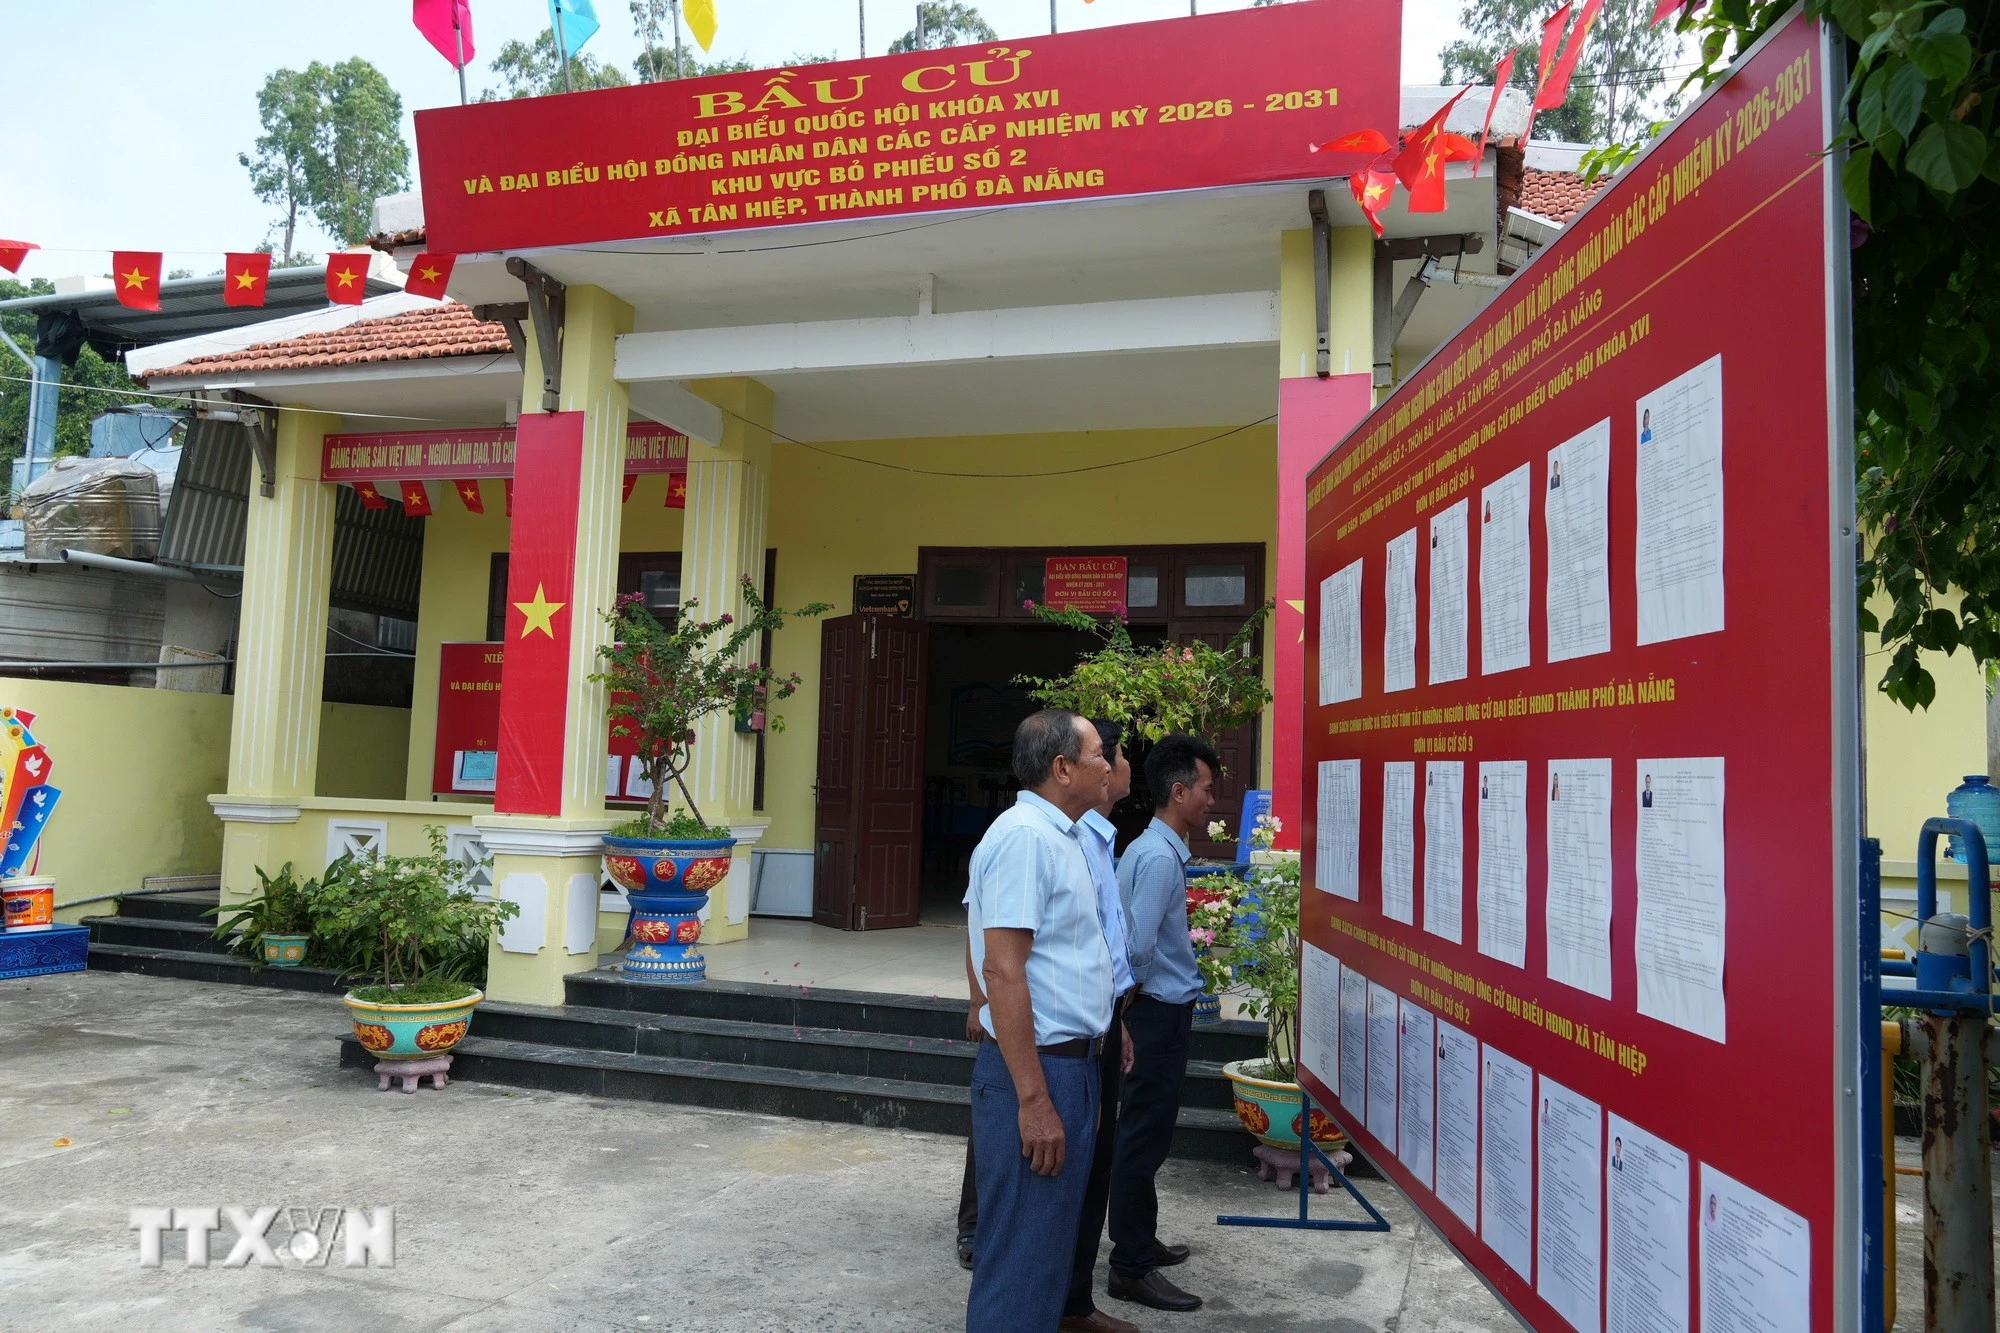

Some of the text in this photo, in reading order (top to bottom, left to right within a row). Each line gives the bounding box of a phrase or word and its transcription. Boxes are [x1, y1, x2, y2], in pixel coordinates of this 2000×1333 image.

[692, 48, 1032, 119] BẦU CỬ
[464, 175, 493, 194] VÀ
[500, 173, 538, 192] ĐẠI
[546, 162, 599, 186] BIỂU
[607, 160, 647, 181] HỘI
[655, 151, 723, 175] ĐỒNG
[732, 143, 804, 167] NHÂN
[813, 137, 867, 158] DÂN
[877, 130, 930, 151] CÁC
[941, 119, 996, 144] CẤP
[1006, 113, 1100, 138] NHIỆM
[1112, 105, 1148, 128] KỲ
[1159, 99, 1232, 123] 2026
[1266, 88, 1337, 111] 2031
[677, 89, 1059, 148] ĐẠI BIỂU QUỐC HỘI KHÓA XVI
[712, 145, 1026, 195] KHU VỰC BỎ PHIẾU SỐ 2
[649, 167, 1104, 227] XÃ TÂN HIỆP, THÀNH PHỐ ĐÀ NẴNG
[1467, 331, 1482, 378] QUỐC
[1484, 323, 1494, 366] HỘI
[1495, 308, 1512, 352] KHÓA
[1514, 300, 1524, 337] XVI
[1526, 284, 1536, 325] VÀ
[1538, 273, 1550, 320] HỘI
[1552, 254, 1574, 305] ĐỒNG
[1577, 232, 1601, 285] NHÂN
[1604, 213, 1623, 263] DÂN
[1626, 192, 1645, 244] CÁC
[1649, 163, 1670, 225] CẤP
[1673, 135, 1712, 205] NHIỆM
[1716, 110, 1732, 170] KỲ
[1736, 48, 1811, 153] 2026-2031
[1393, 441, 1400, 464] SỐ
[1401, 444, 1406, 459] 2
[1408, 429, 1423, 453] THÔN
[1424, 419, 1433, 441] BÃI
[1437, 406, 1455, 432] LÀNG,
[1457, 392, 1466, 417] XÃ
[1468, 383, 1481, 407] TÂN
[1483, 368, 1500, 396] HIỆP,
[1502, 344, 1529, 381] THÀNH
[1532, 316, 1551, 359] PHỐ
[1554, 310, 1568, 342] ĐÀ
[1571, 289, 1602, 329] NẴNG
[1425, 460, 1435, 481] TẮT
[1459, 431, 1479, 459] NGƯỜI
[1481, 420, 1496, 444] ỨNG
[1498, 406, 1509, 432] CỬ
[1510, 400, 1523, 424] ĐẠI
[1526, 381, 1545, 414] BIỂU
[1548, 363, 1573, 399] QUỐC
[1576, 351, 1593, 380] HỘI
[1596, 330, 1626, 367] KHÓA
[1630, 313, 1649, 345] XVI
[330, 441, 350, 469] ĐẢNG
[351, 442, 371, 473] CỘNG
[372, 439, 387, 468] SẢN
[389, 441, 404, 472] VIỆT
[405, 444, 422, 466] NAM
[428, 438, 451, 465] NGƯỜI
[452, 438, 471, 465] LÃNH
[473, 442, 490, 469] ĐẠO,
[492, 433, 502, 464] TỔ
[502, 441, 516, 464] CH
[649, 431, 666, 464] VIỆT
[667, 435, 687, 458] NAM
[1429, 490, 1434, 507] VỊ
[1436, 479, 1448, 502] BẦU
[1449, 471, 1459, 494] CỬ
[1459, 463, 1468, 488] SỐ
[1470, 466, 1474, 481] 4
[1055, 560, 1117, 571] BAN BẦU CỬ
[859, 605, 899, 613] Vietcombank
[1078, 589, 1091, 597] BẦU
[1102, 589, 1112, 597] SỐ
[484, 651, 504, 664] NIÊ
[450, 681, 460, 691] VÀ
[462, 682, 475, 692] ĐẠI
[476, 679, 494, 691] BIỂU
[1392, 709, 1401, 727] SỬ
[1412, 706, 1421, 725] TẮT
[1422, 707, 1442, 724] NHỮNG
[1444, 703, 1463, 723] NGƯỜI
[1465, 702, 1480, 721] ỨNG
[1482, 697, 1494, 719] CỬ
[1493, 700, 1506, 721] ĐẠI
[1508, 690, 1527, 716] BIỂU
[1529, 694, 1554, 714] HĐND
[1557, 687, 1589, 711] THÀNH
[1593, 678, 1615, 708] PHỐ
[1618, 679, 1634, 705] ĐÀ
[1638, 673, 1674, 703] NẴNG
[1414, 730, 1473, 755] ĐƠN VỊ BẦU CỬ SỐ 9
[1399, 943, 1406, 961] SỬ
[1420, 952, 1430, 973] TẮT
[1431, 960, 1452, 985] NHỮNG
[1454, 971, 1474, 995] NGƯỜI
[1477, 978, 1491, 1003] ỨNG
[1494, 985, 1505, 1008] CỬ
[1507, 994, 1520, 1018] ĐẠI
[1523, 998, 1543, 1026] BIỂU
[1546, 1011, 1572, 1040] HĐND
[1576, 1024, 1590, 1049] XÃ
[1593, 1031, 1615, 1061] TÂN
[1619, 1043, 1646, 1076] HIỆP
[1411, 979, 1469, 1024] ĐƠN VỊ BẦU CỬ SỐ 2
